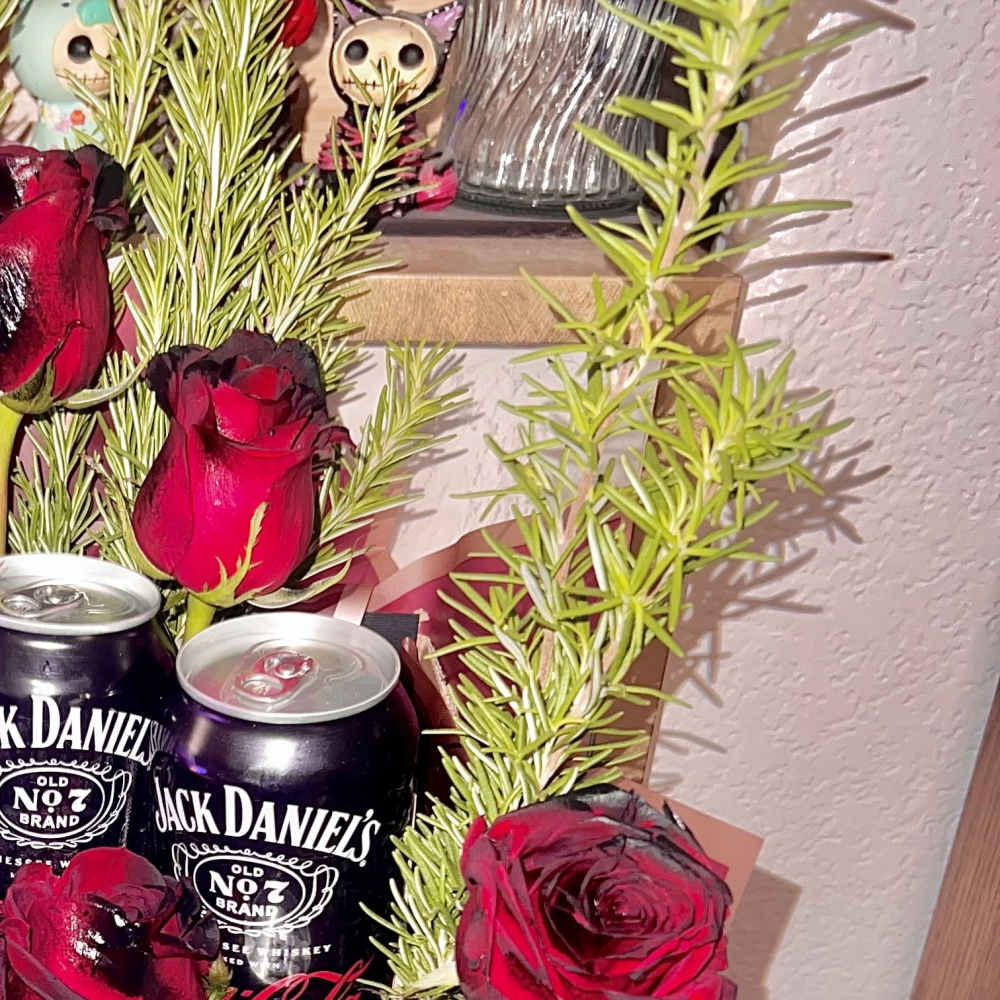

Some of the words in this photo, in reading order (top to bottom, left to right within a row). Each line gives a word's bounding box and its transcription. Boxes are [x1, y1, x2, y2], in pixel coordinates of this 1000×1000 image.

[36, 776, 69, 788] OLD
[19, 813, 80, 829] BRAND
[154, 776, 220, 834] JACK
[223, 784, 381, 867] DANIEL'S
[230, 864, 264, 878] OLD
[216, 897, 280, 917] BRAND
